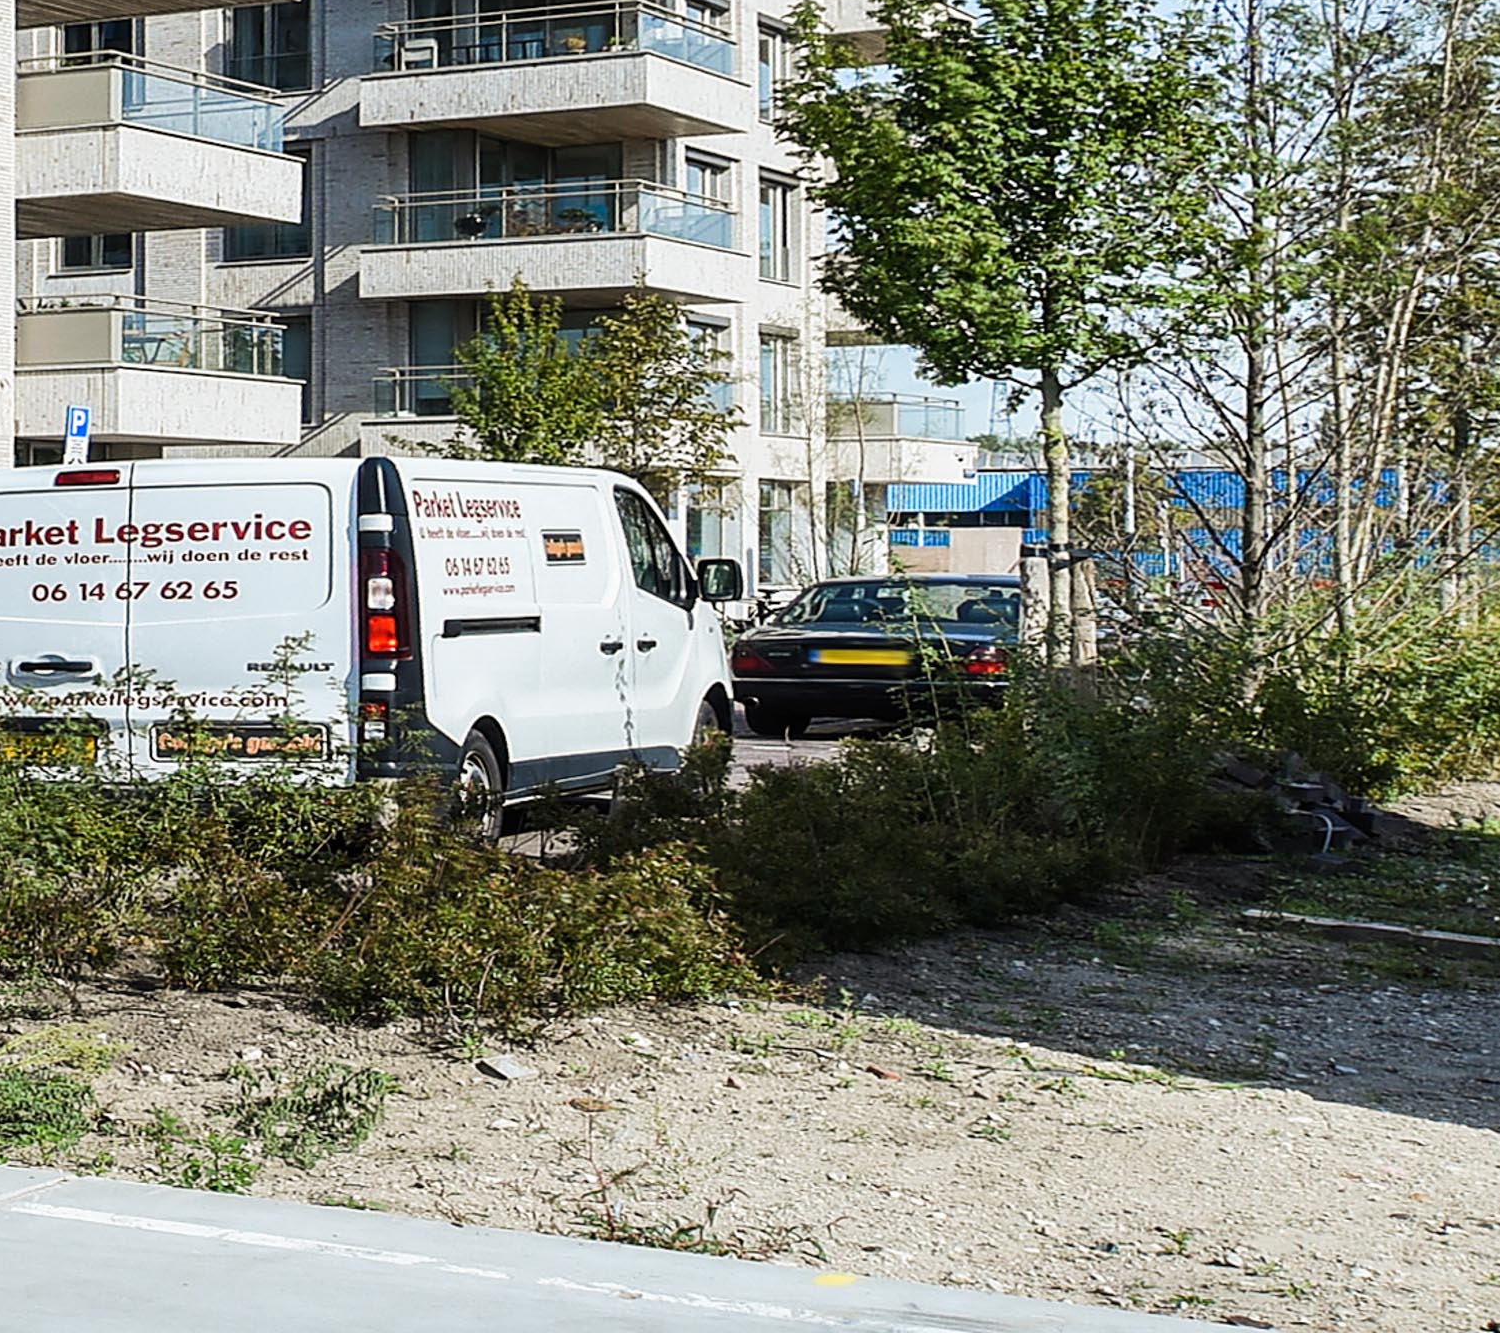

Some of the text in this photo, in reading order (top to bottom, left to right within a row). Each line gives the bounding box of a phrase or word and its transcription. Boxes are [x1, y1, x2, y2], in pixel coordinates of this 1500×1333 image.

[72, 410, 86, 435] P
[412, 490, 522, 524] Parket Legservice
[94, 513, 312, 548] Legservice
[36, 554, 57, 566] de
[182, 550, 229, 562] doen
[237, 549, 261, 561] de
[269, 549, 309, 561] rest
[32, 581, 238, 602] 06 14 67 62 65
